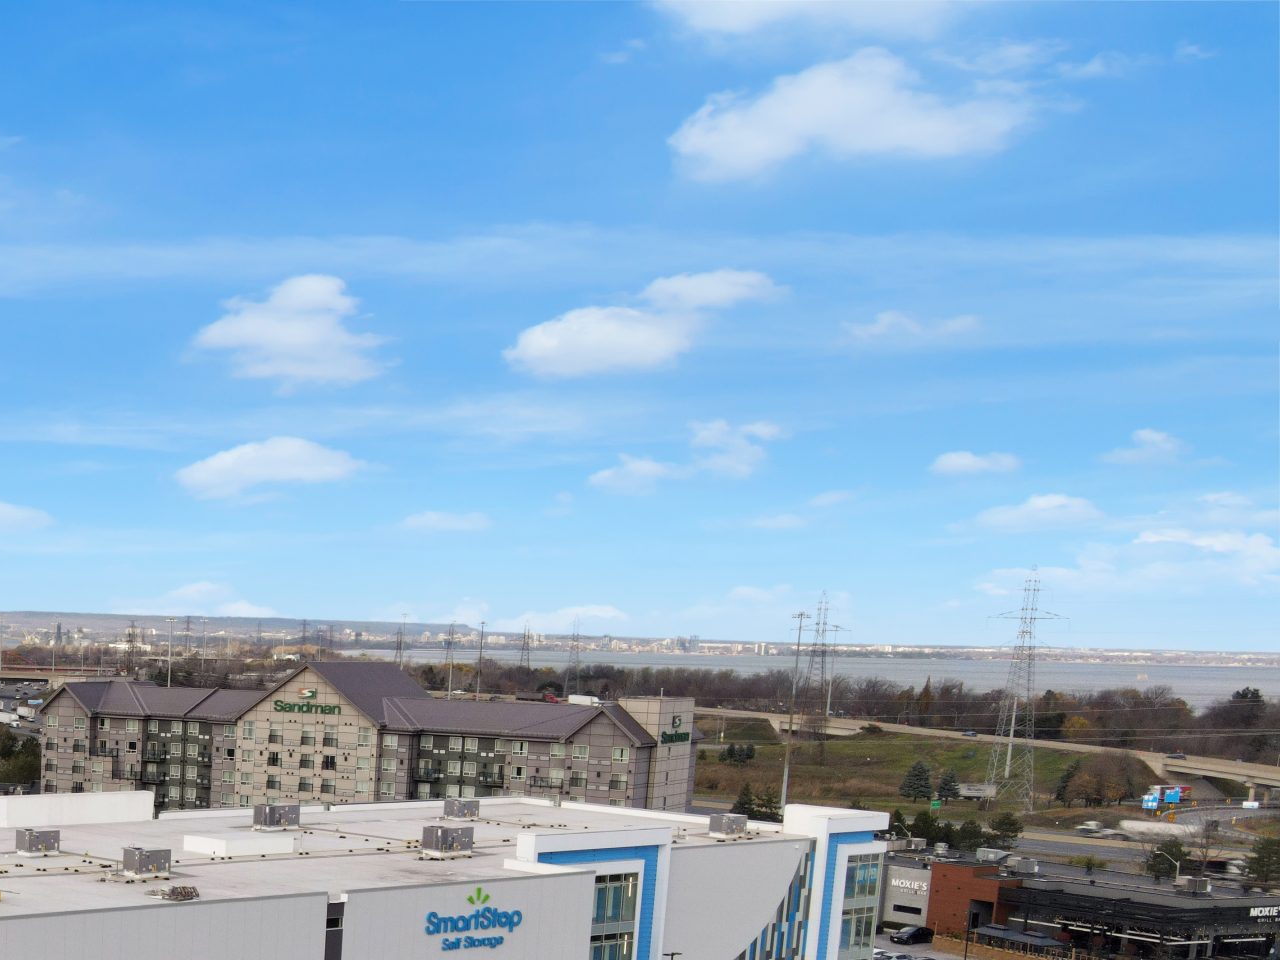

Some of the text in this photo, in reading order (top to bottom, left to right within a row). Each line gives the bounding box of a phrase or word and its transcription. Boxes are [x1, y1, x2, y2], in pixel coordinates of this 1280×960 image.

[273, 699, 342, 716] Sandman
[891, 878, 928, 891] MOXIE'S
[1250, 906, 1280, 917] MOXIE'
[425, 906, 523, 935] SmartStop
[441, 935, 505, 952] Self Storage
